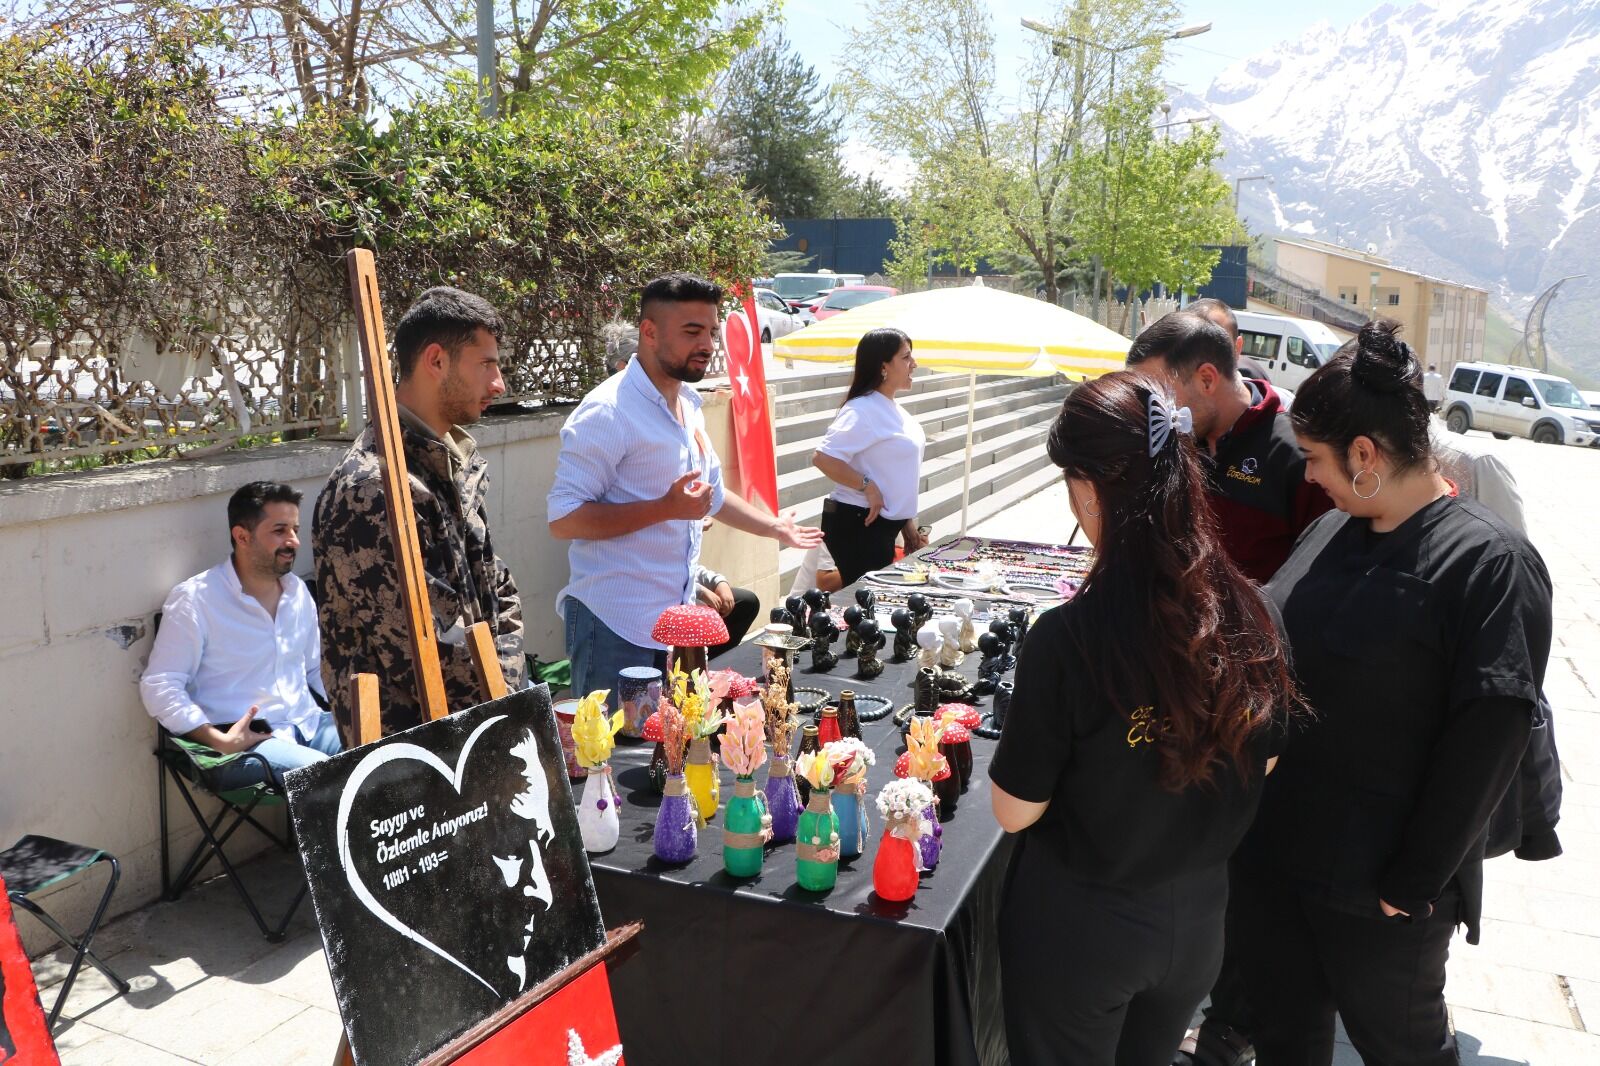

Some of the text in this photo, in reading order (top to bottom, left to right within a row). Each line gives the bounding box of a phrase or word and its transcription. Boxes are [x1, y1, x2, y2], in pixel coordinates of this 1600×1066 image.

[370, 804, 425, 838] Saygı ve
[376, 801, 488, 864] Özlemle Anıyoruz!
[383, 865, 410, 890] 1881
